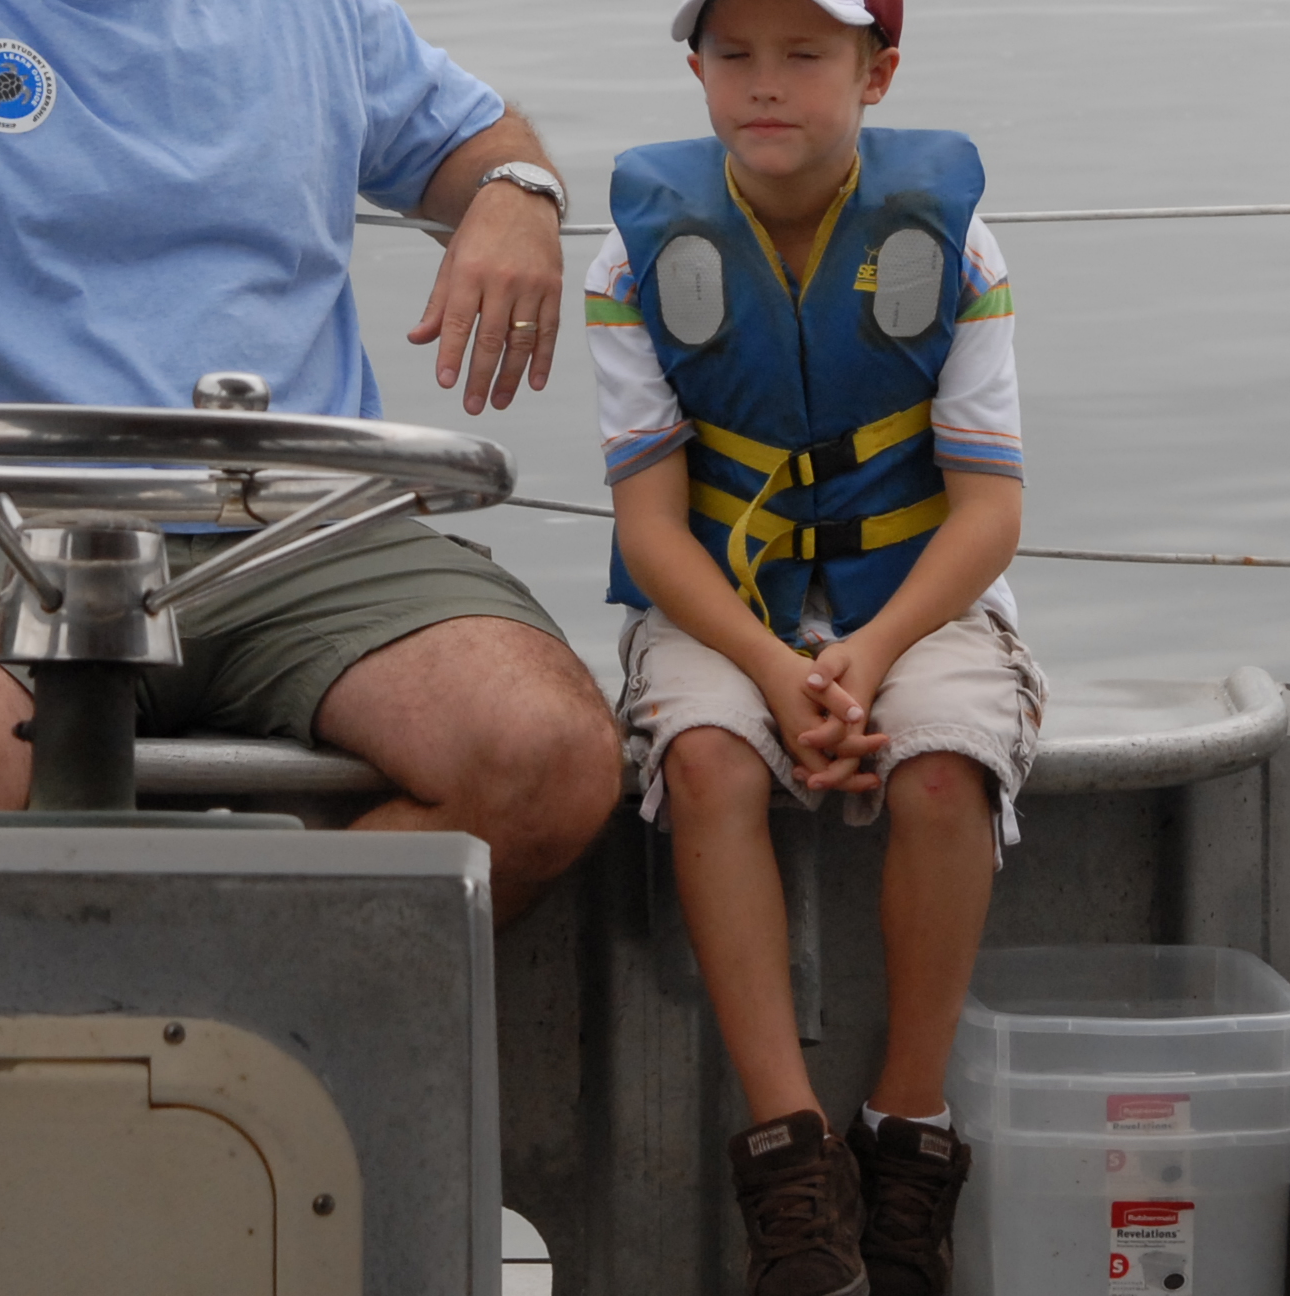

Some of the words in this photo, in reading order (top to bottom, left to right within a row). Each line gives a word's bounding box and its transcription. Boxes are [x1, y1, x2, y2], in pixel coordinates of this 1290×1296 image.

[3, 53, 32, 68] LEARN
[31, 69, 43, 107] OUTSIDE
[11, 44, 46, 69] STUDENT
[32, 71, 52, 122] LEADERSHIP
[858, 266, 877, 277] SE
[1127, 1214, 1176, 1222] Rubbermaid
[1117, 1229, 1177, 1239] Revelations
[1112, 1260, 1123, 1274] S
